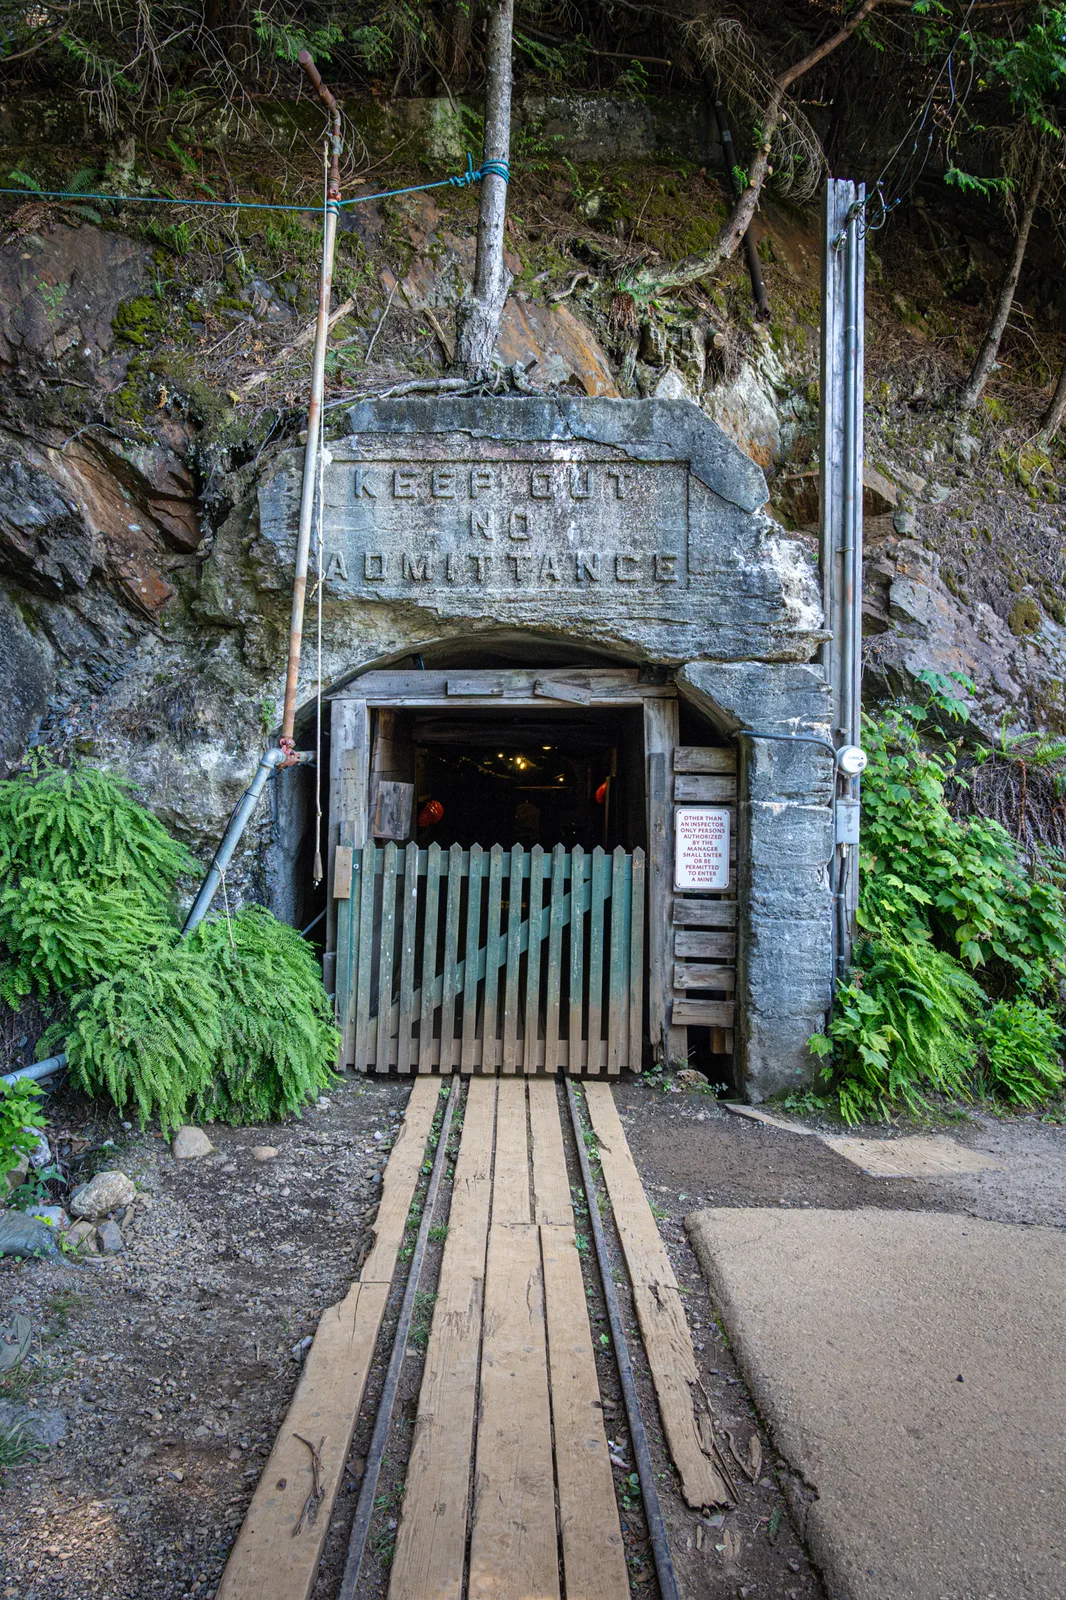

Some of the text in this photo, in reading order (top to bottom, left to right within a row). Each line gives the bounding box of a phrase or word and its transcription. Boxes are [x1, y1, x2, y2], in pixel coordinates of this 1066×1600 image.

[353, 469, 631, 499] KEEP OUT
[471, 510, 532, 541] NO
[326, 551, 678, 582] ADMITTANCE
